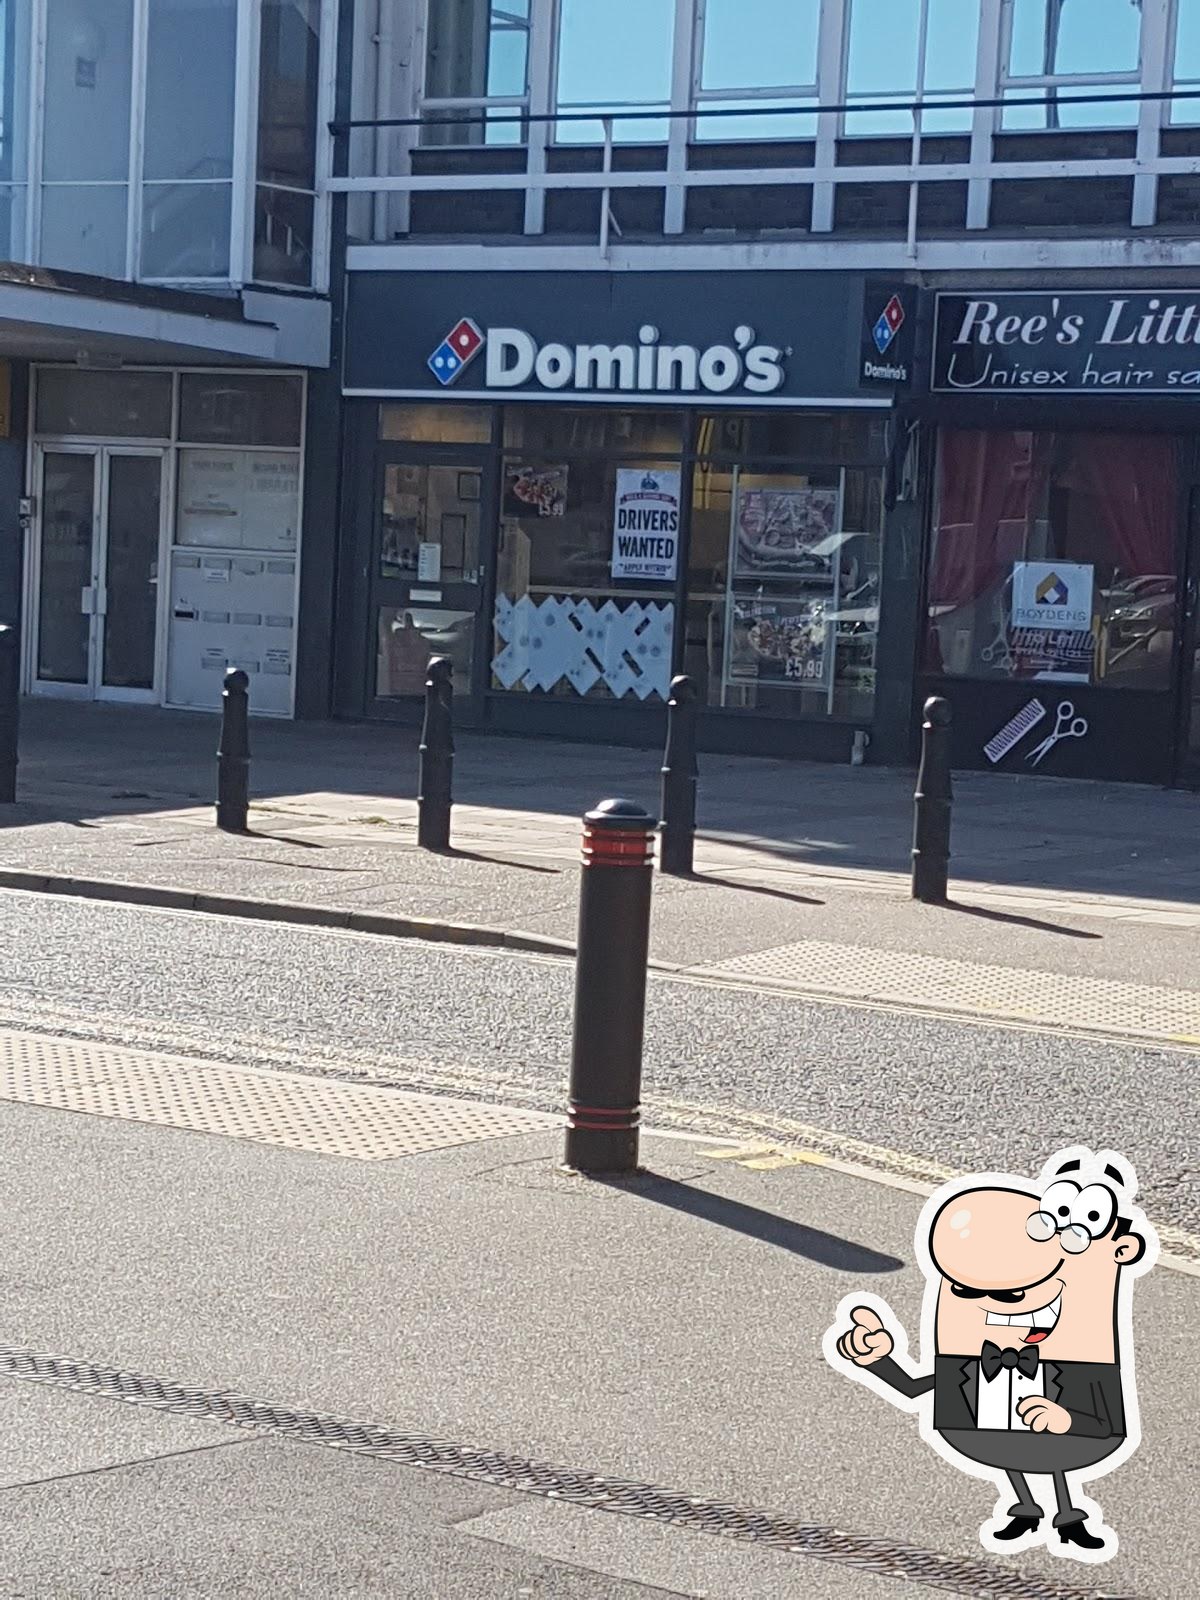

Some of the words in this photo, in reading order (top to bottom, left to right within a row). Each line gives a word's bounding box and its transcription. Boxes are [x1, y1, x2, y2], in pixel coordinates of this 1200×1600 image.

[952, 297, 1084, 345] Ree's
[485, 324, 785, 392] Domino's
[864, 361, 907, 380] Domino's
[947, 353, 1068, 388] Unisex
[1081, 353, 1153, 385] hair
[618, 509, 678, 531] DRIVERS
[618, 536, 674, 559] WANTED
